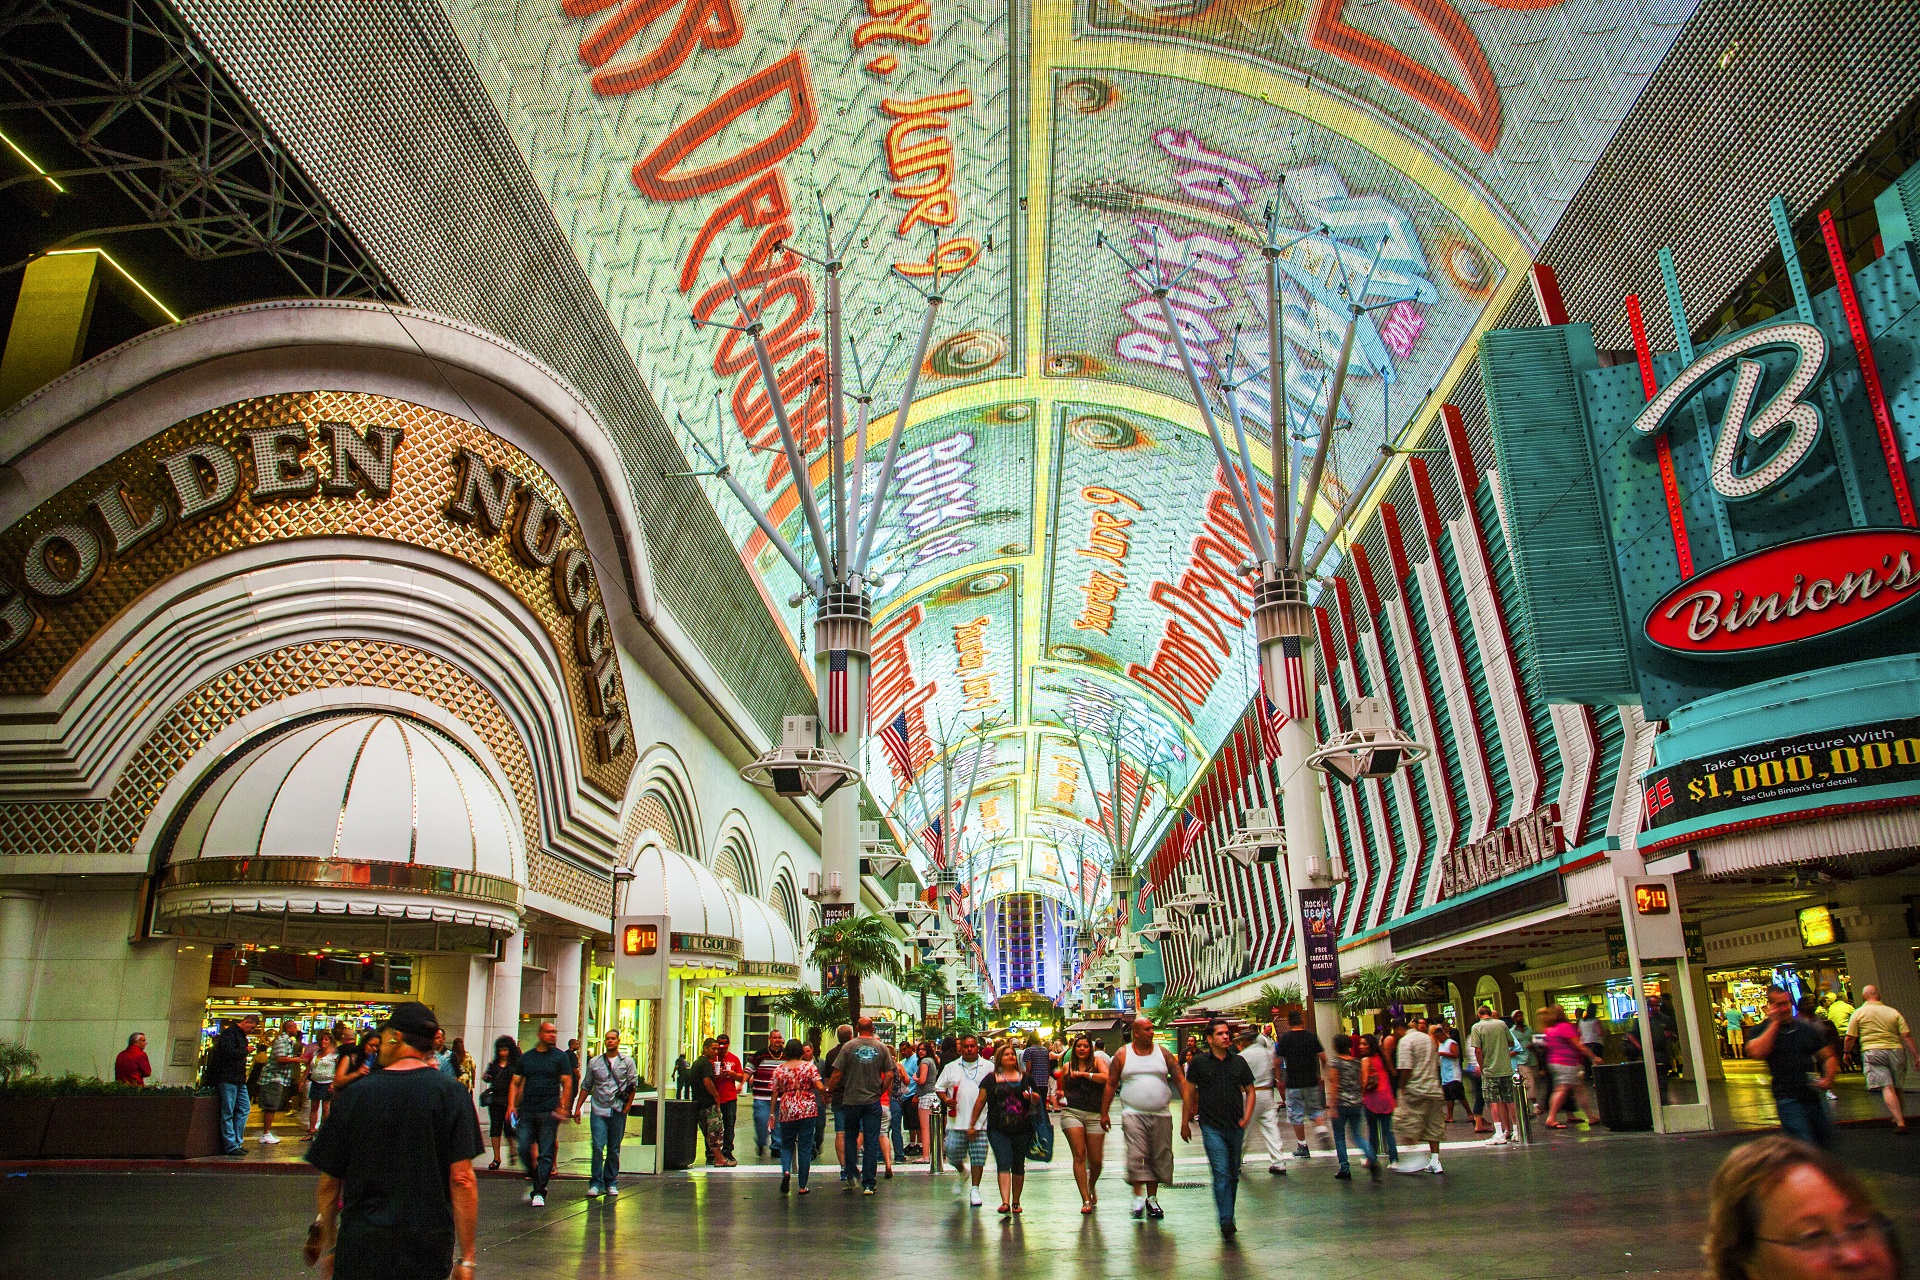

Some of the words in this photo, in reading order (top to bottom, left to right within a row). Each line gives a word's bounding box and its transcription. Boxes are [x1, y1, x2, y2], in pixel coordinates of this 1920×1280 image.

[1116, 219, 1244, 379] ROCK
[1632, 321, 1831, 501] B
[894, 431, 979, 538] ROCK
[444, 446, 627, 765] NUGGET
[1665, 550, 1920, 641] Binion's
[1687, 737, 1920, 803] $1,000,000
[1703, 757, 1737, 774] Take
[1739, 750, 1777, 764] Your
[1781, 737, 1845, 757] Picture
[1847, 728, 1895, 745] With
[1741, 793, 1756, 802] See
[1757, 789, 1777, 800] Club
[1778, 784, 1811, 795] Binion's
[1812, 780, 1826, 789] for
[1826, 776, 1858, 788] details
[1441, 803, 1557, 899] GAMBLING
[826, 910, 843, 918] ROCK
[1304, 900, 1321, 908] ROCK
[1651, 890, 1667, 908] 14
[642, 931, 656, 949] 14
